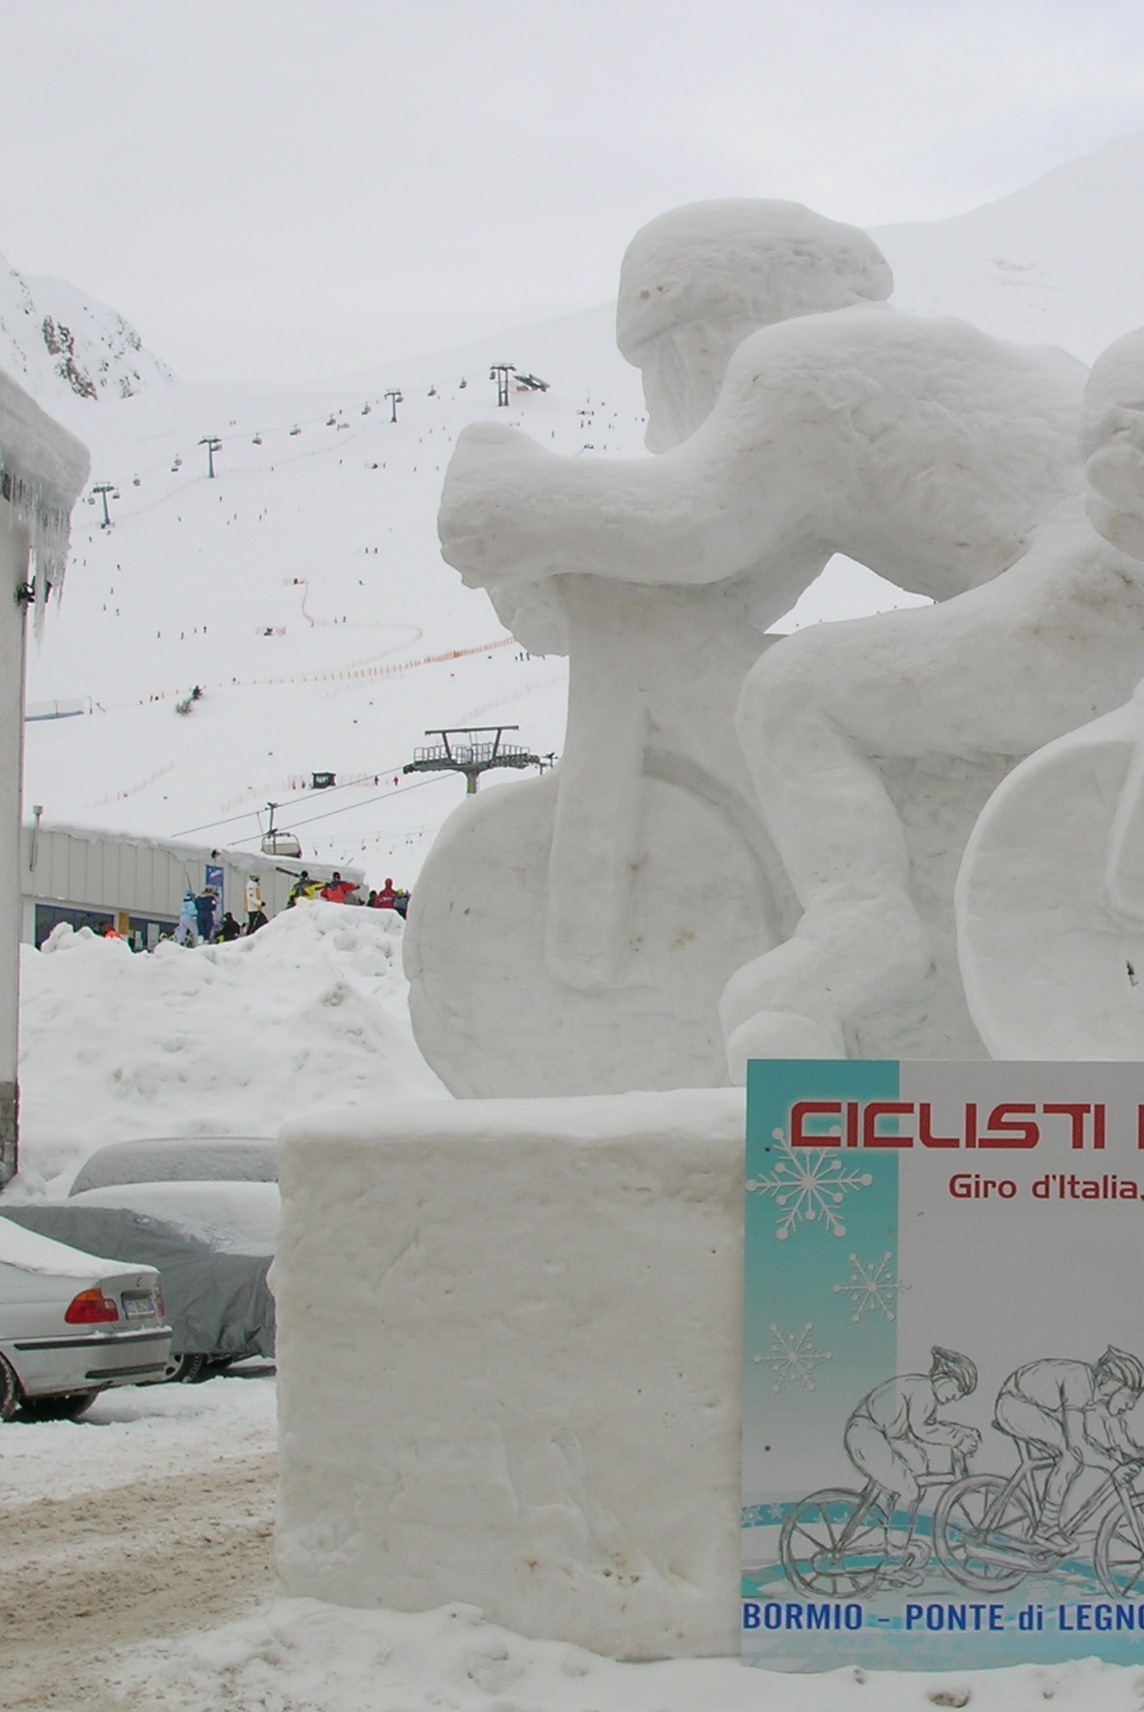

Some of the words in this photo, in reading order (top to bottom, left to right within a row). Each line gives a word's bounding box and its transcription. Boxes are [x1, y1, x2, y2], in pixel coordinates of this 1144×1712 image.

[791, 1101, 1105, 1150] CICLISTI
[949, 1173, 1017, 1199] Giro
[742, 1602, 863, 1630] BORMIO
[905, 1603, 1004, 1631] PONTE
[1018, 1603, 1044, 1631] di
